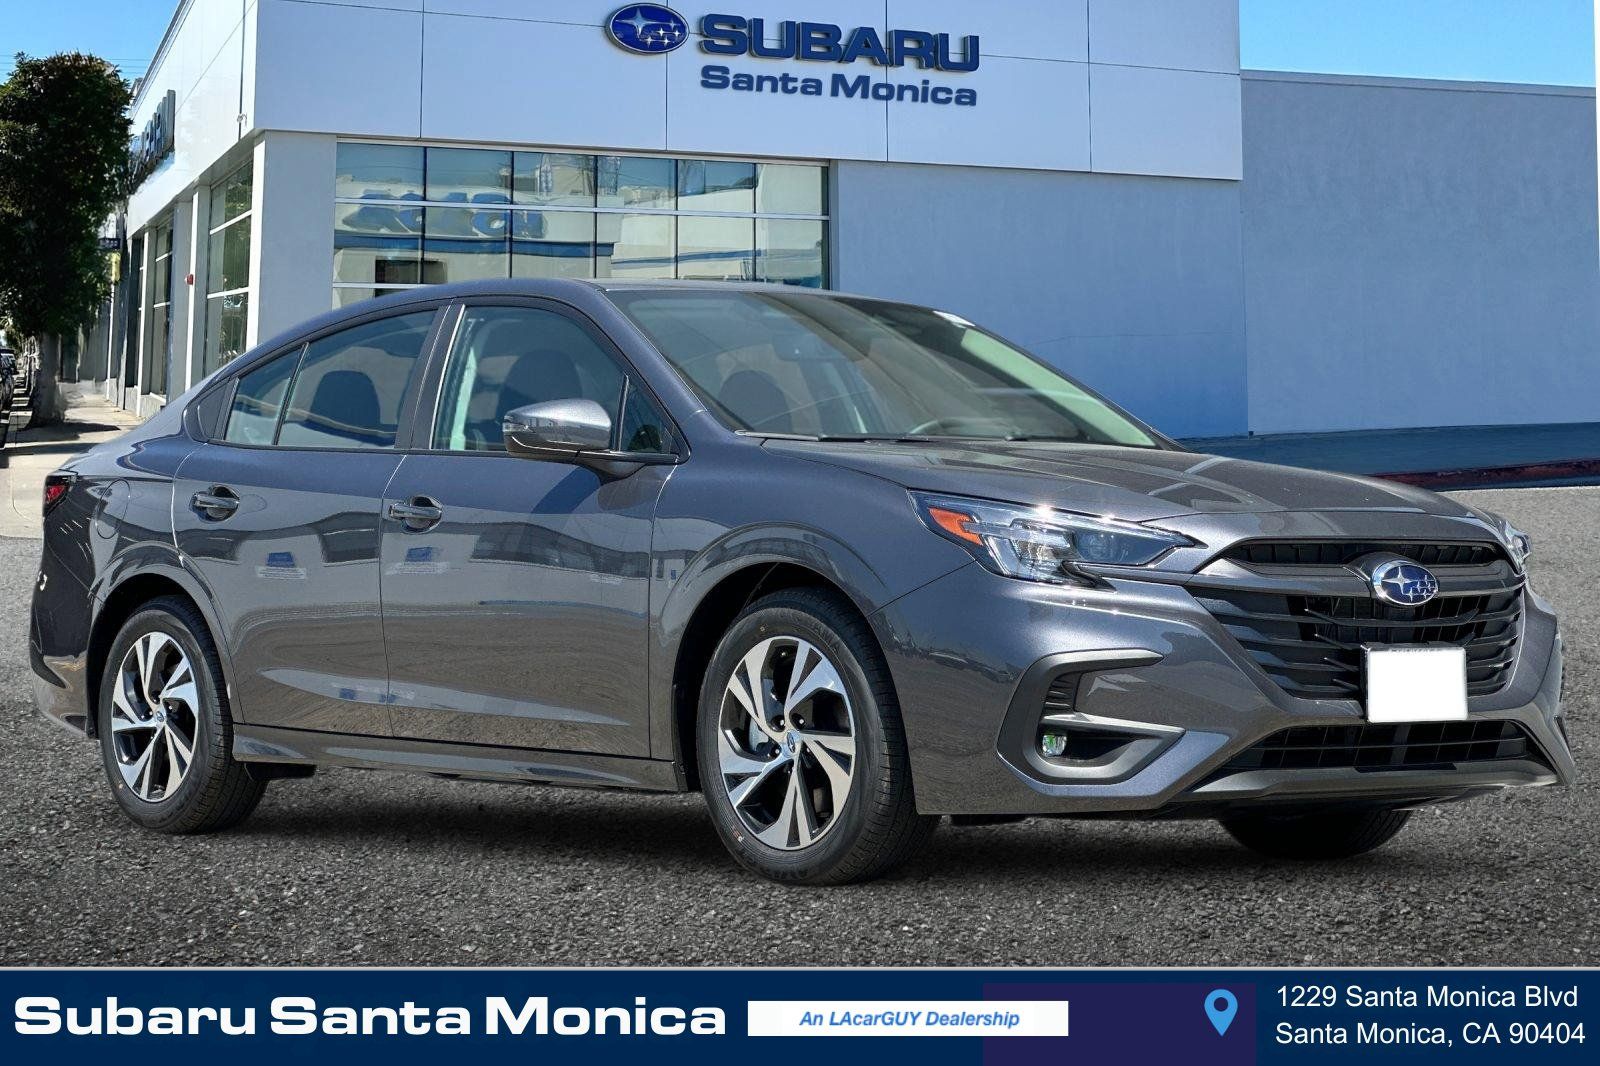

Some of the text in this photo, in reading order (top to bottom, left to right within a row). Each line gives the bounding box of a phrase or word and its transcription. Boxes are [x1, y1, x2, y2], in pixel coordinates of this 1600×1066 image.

[701, 13, 980, 72] SUBARU
[700, 64, 978, 107] Santa Monica
